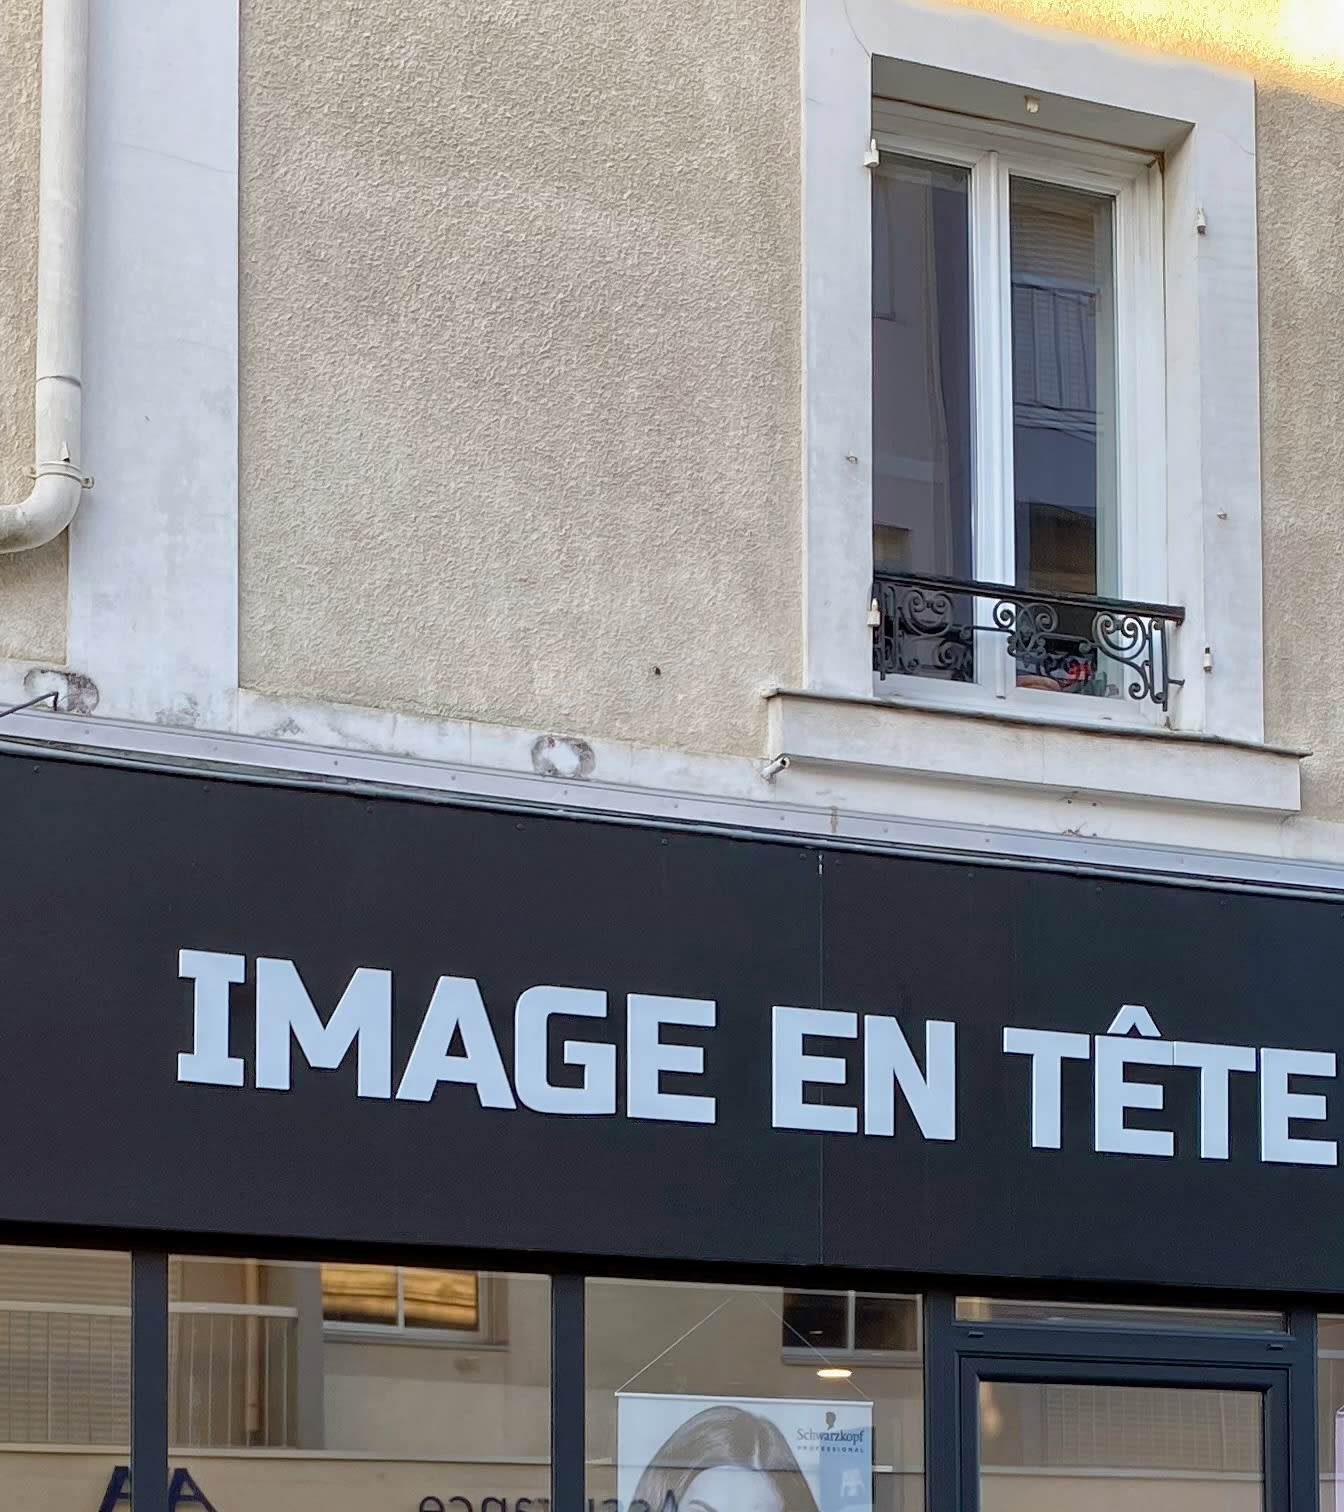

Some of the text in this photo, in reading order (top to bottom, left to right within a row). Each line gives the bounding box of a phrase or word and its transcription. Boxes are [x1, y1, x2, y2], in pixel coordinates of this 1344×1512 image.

[176, 948, 1338, 1166] IMAGE EN TÊTE
[796, 1428, 865, 1445] Schwarzkopf
